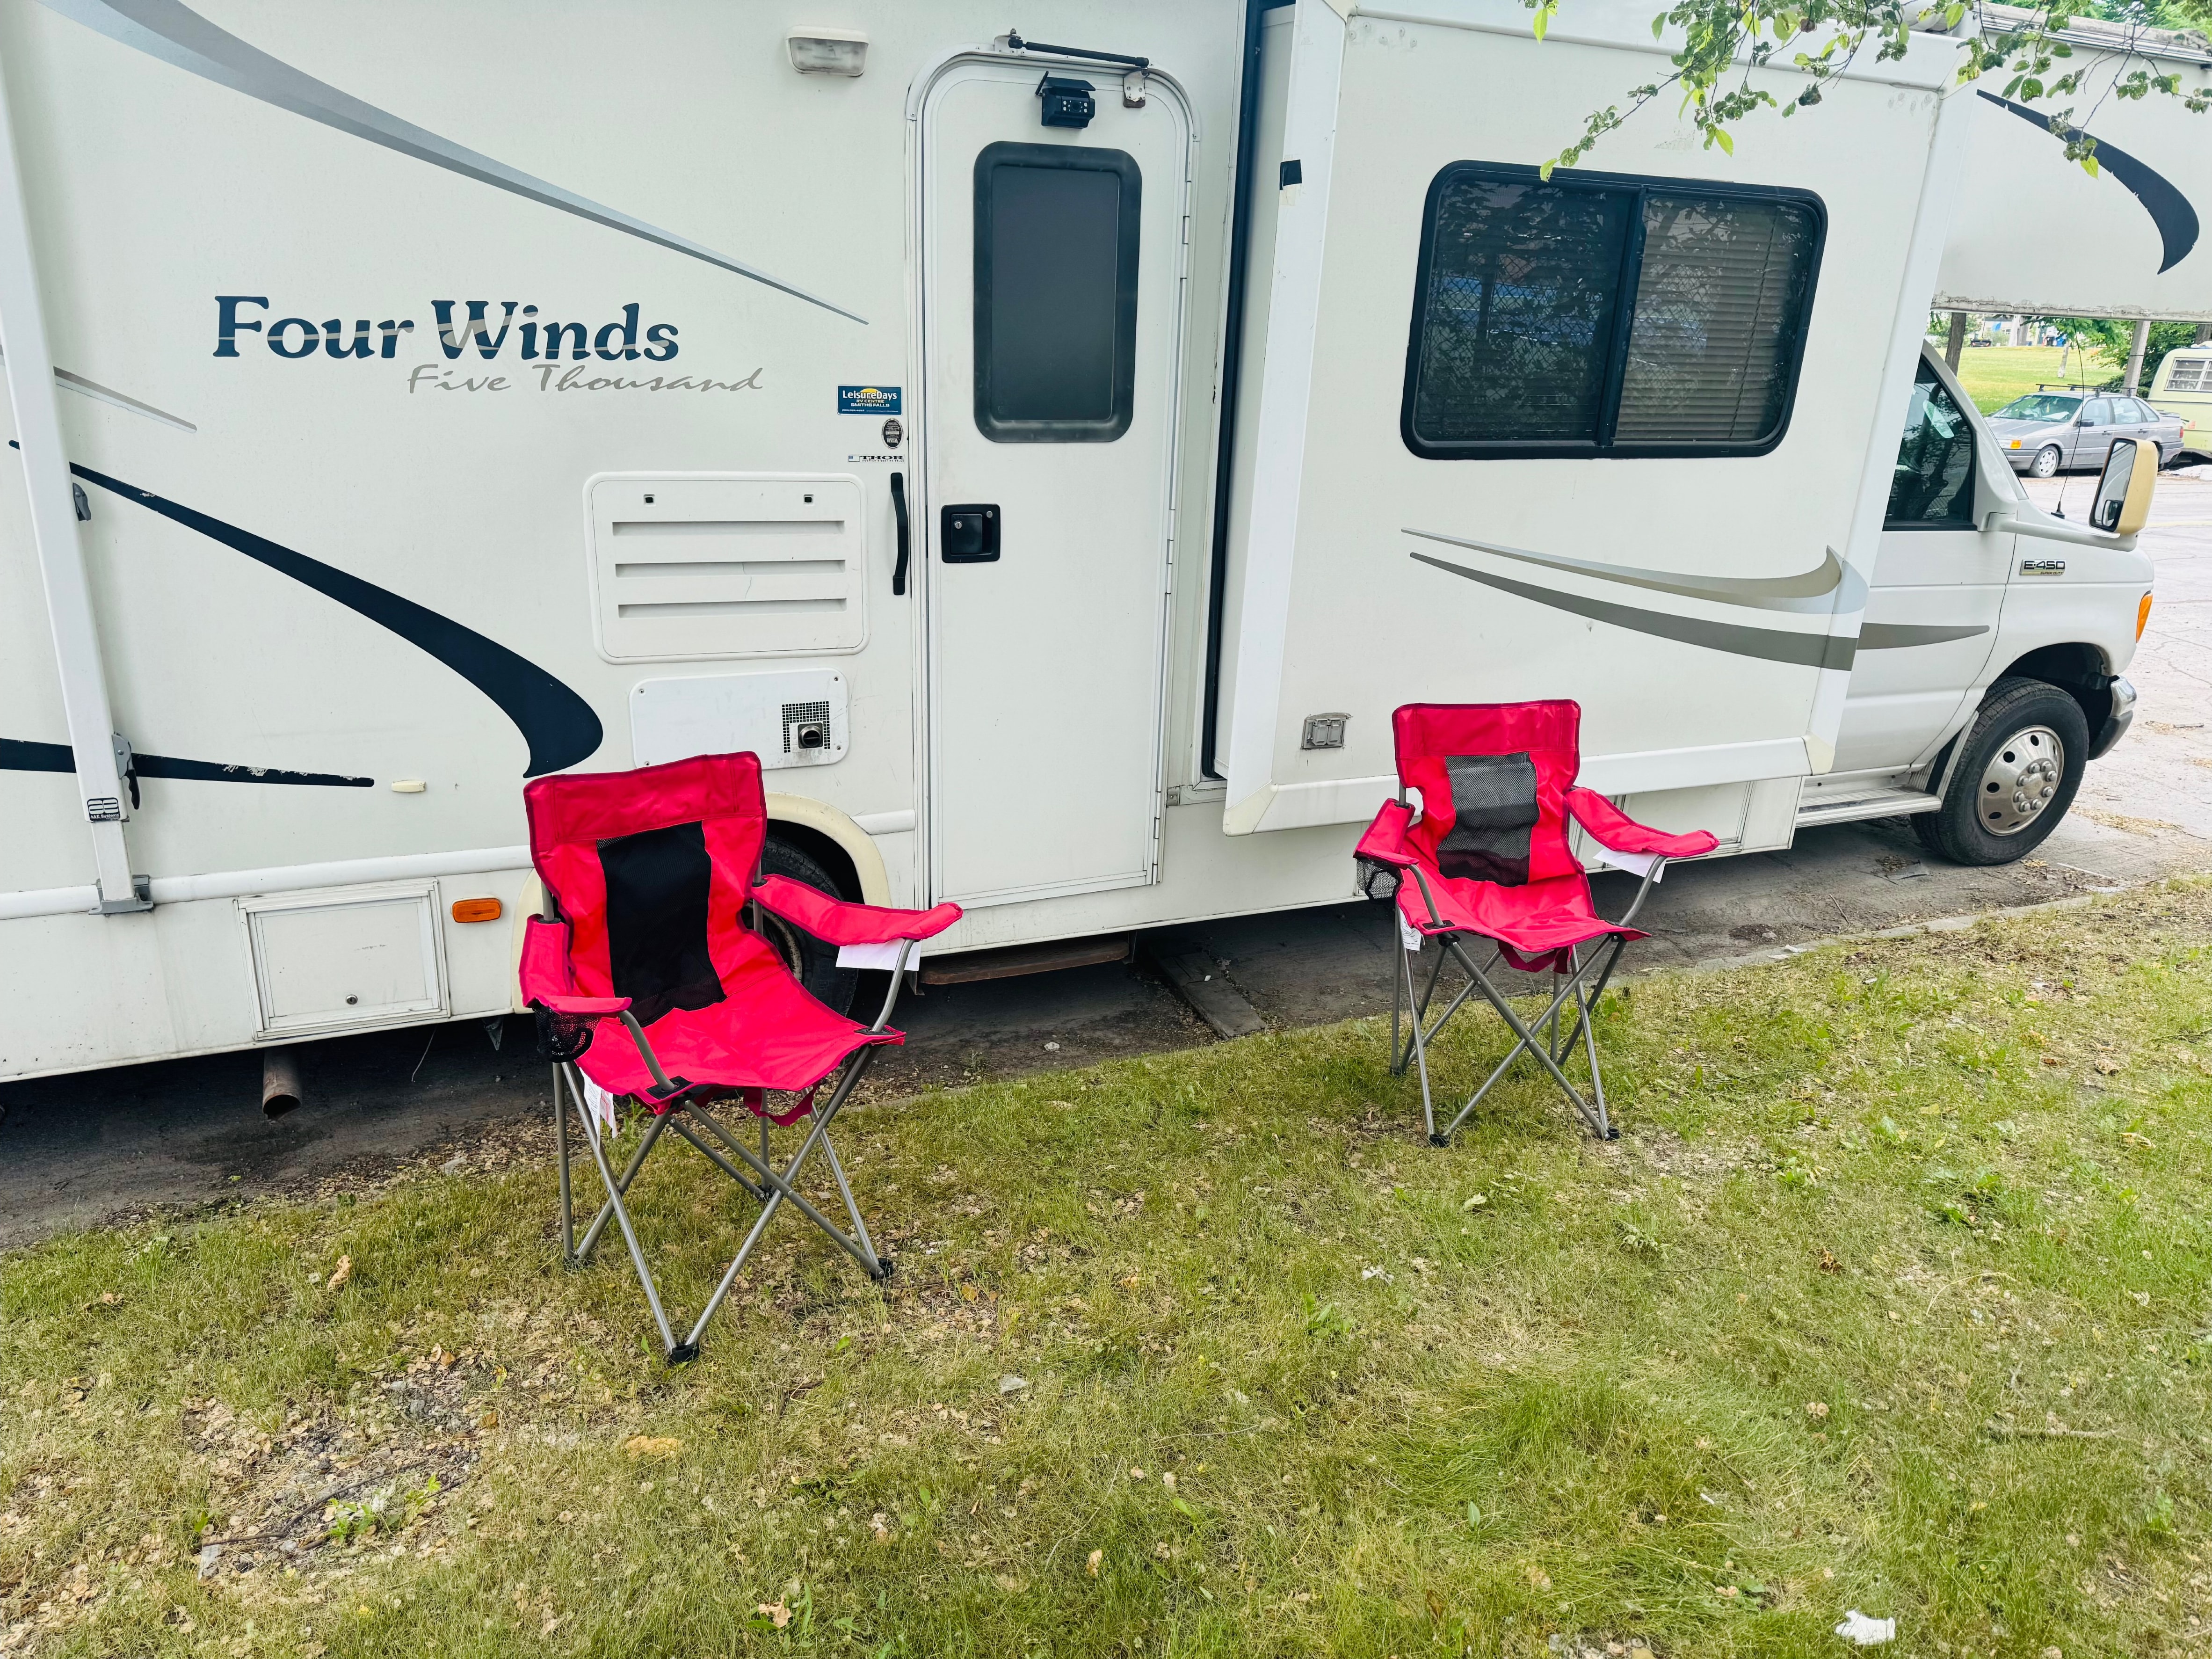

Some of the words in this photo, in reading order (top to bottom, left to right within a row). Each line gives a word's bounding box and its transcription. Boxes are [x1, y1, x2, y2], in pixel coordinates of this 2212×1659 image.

[212, 295, 414, 359] Four
[431, 300, 680, 362] Winds
[408, 364, 513, 394] Five
[531, 364, 764, 393] Thousand
[842, 390, 897, 400] LeisureDays
